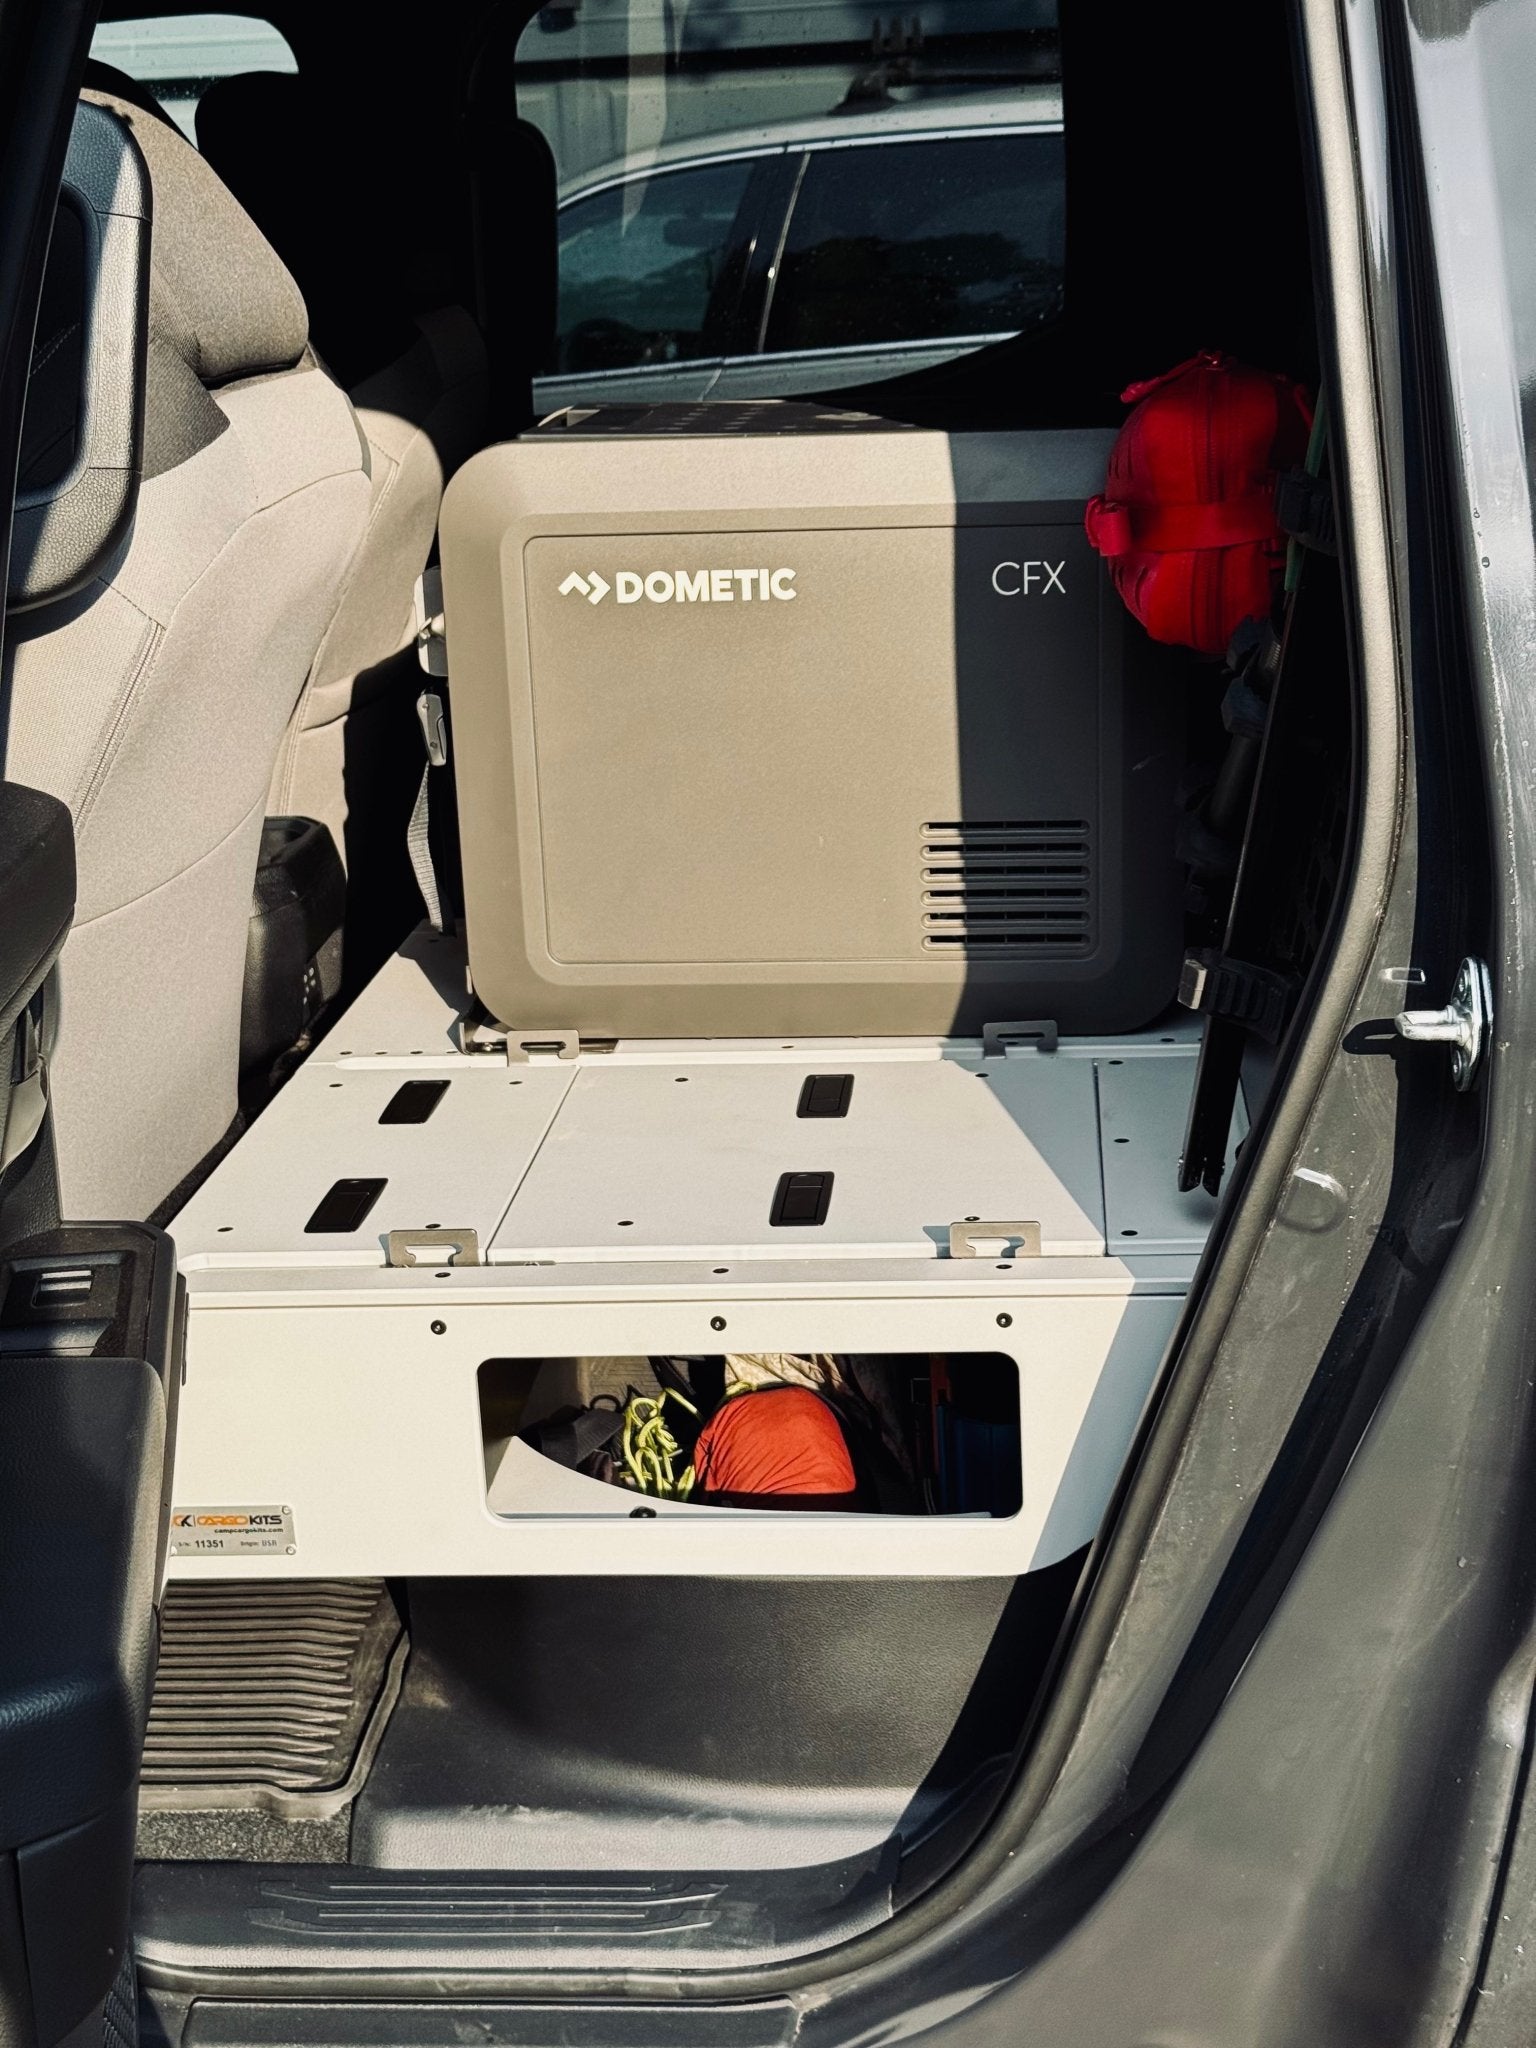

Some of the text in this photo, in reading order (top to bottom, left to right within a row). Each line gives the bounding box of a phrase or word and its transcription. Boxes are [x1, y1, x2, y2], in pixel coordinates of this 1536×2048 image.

[615, 568, 797, 604] DOMETIC
[992, 561, 1066, 596] CFX
[195, 1539, 224, 1548] 11351
